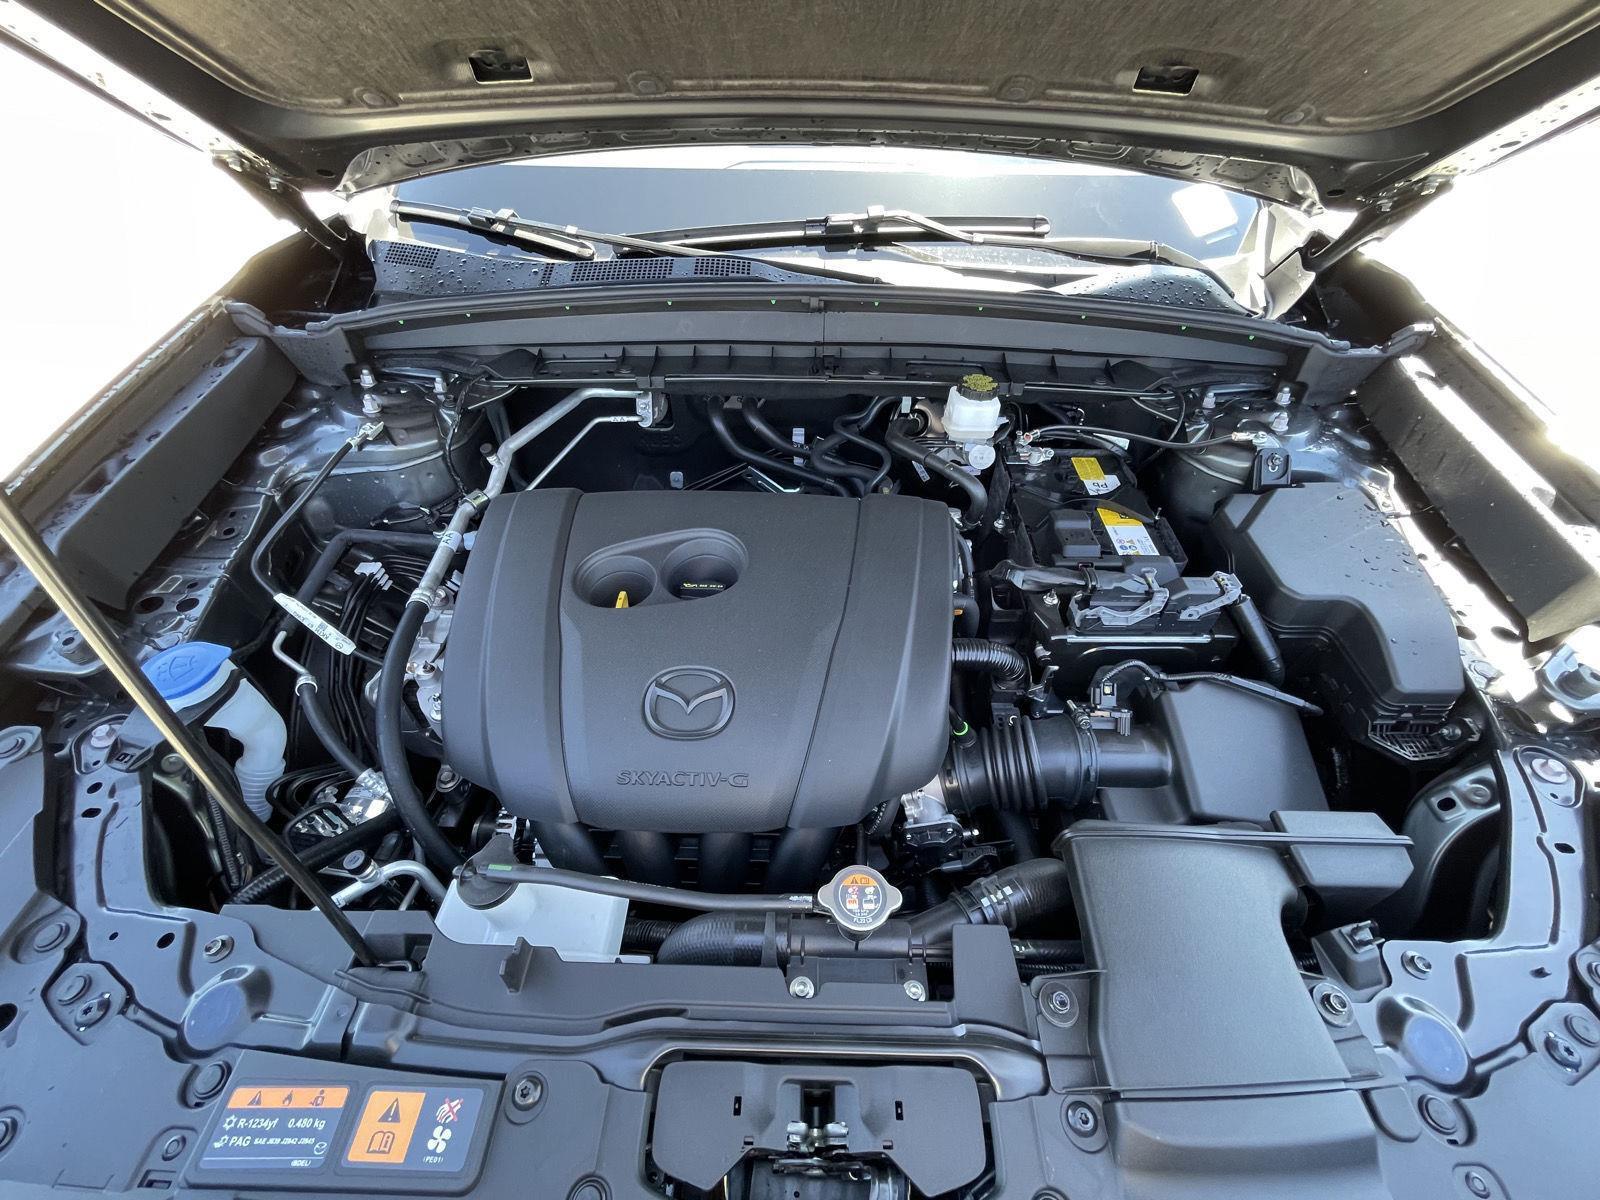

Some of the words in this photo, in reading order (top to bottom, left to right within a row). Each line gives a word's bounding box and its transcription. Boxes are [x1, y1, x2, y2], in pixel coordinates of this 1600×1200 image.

[616, 769, 749, 788] SKYACTIV-G
[236, 1117, 279, 1131] R-1234yf
[287, 1117, 313, 1129] 0.480
[313, 1117, 326, 1130] kg
[228, 1135, 252, 1147] PAG
